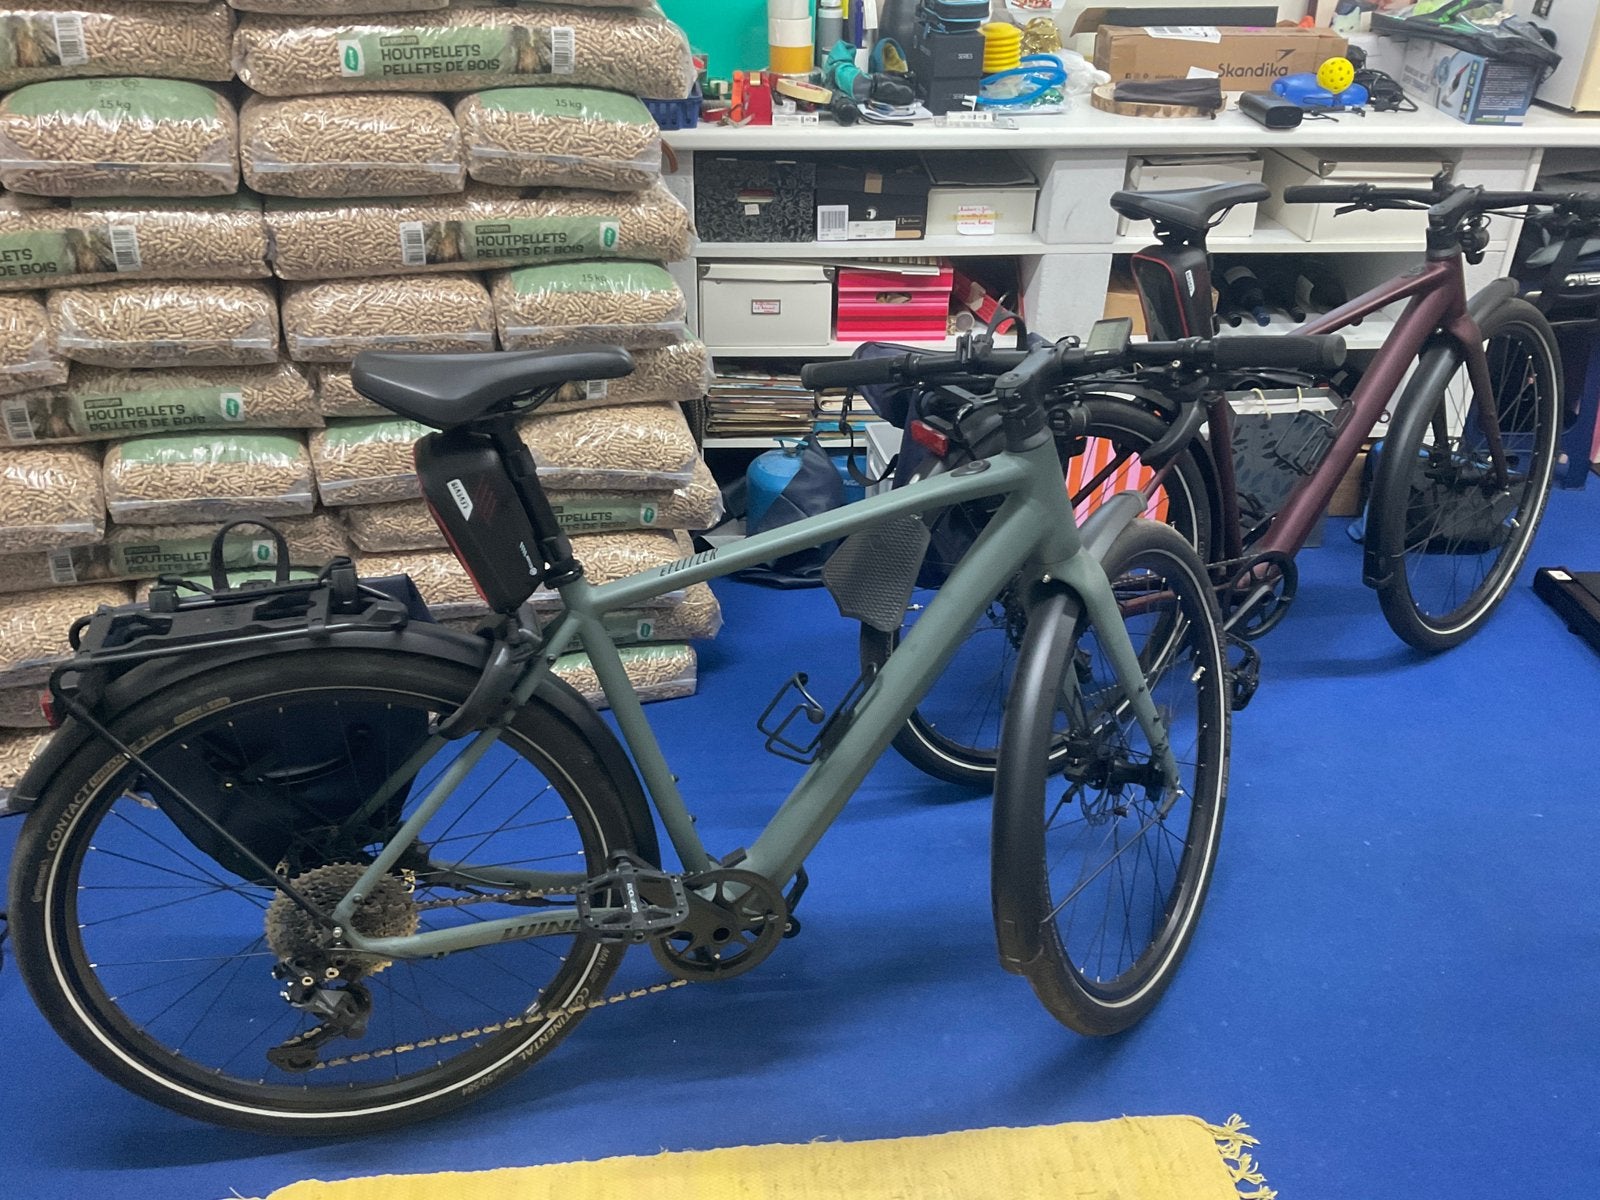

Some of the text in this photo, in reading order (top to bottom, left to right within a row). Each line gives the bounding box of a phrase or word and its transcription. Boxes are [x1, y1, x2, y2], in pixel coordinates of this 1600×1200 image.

[381, 44, 481, 61] HOUTPELLETS
[382, 58, 500, 76] PELLETS DE BOIS
[1217, 62, 1289, 78] Skandika
[555, 98, 582, 111] 15 kg
[476, 232, 567, 247] HOUTPELLETS
[477, 244, 584, 258] PELLETS DE BOIS
[20, 261, 58, 275] BOIS
[85, 404, 186, 421] HOUTPELLETS
[89, 415, 206, 432] PELLETS DE BOIS
[124, 551, 210, 565] HOUTPELLET
[47, 785, 91, 852] CONTACT
[519, 986, 590, 1061] COTINENTAL
